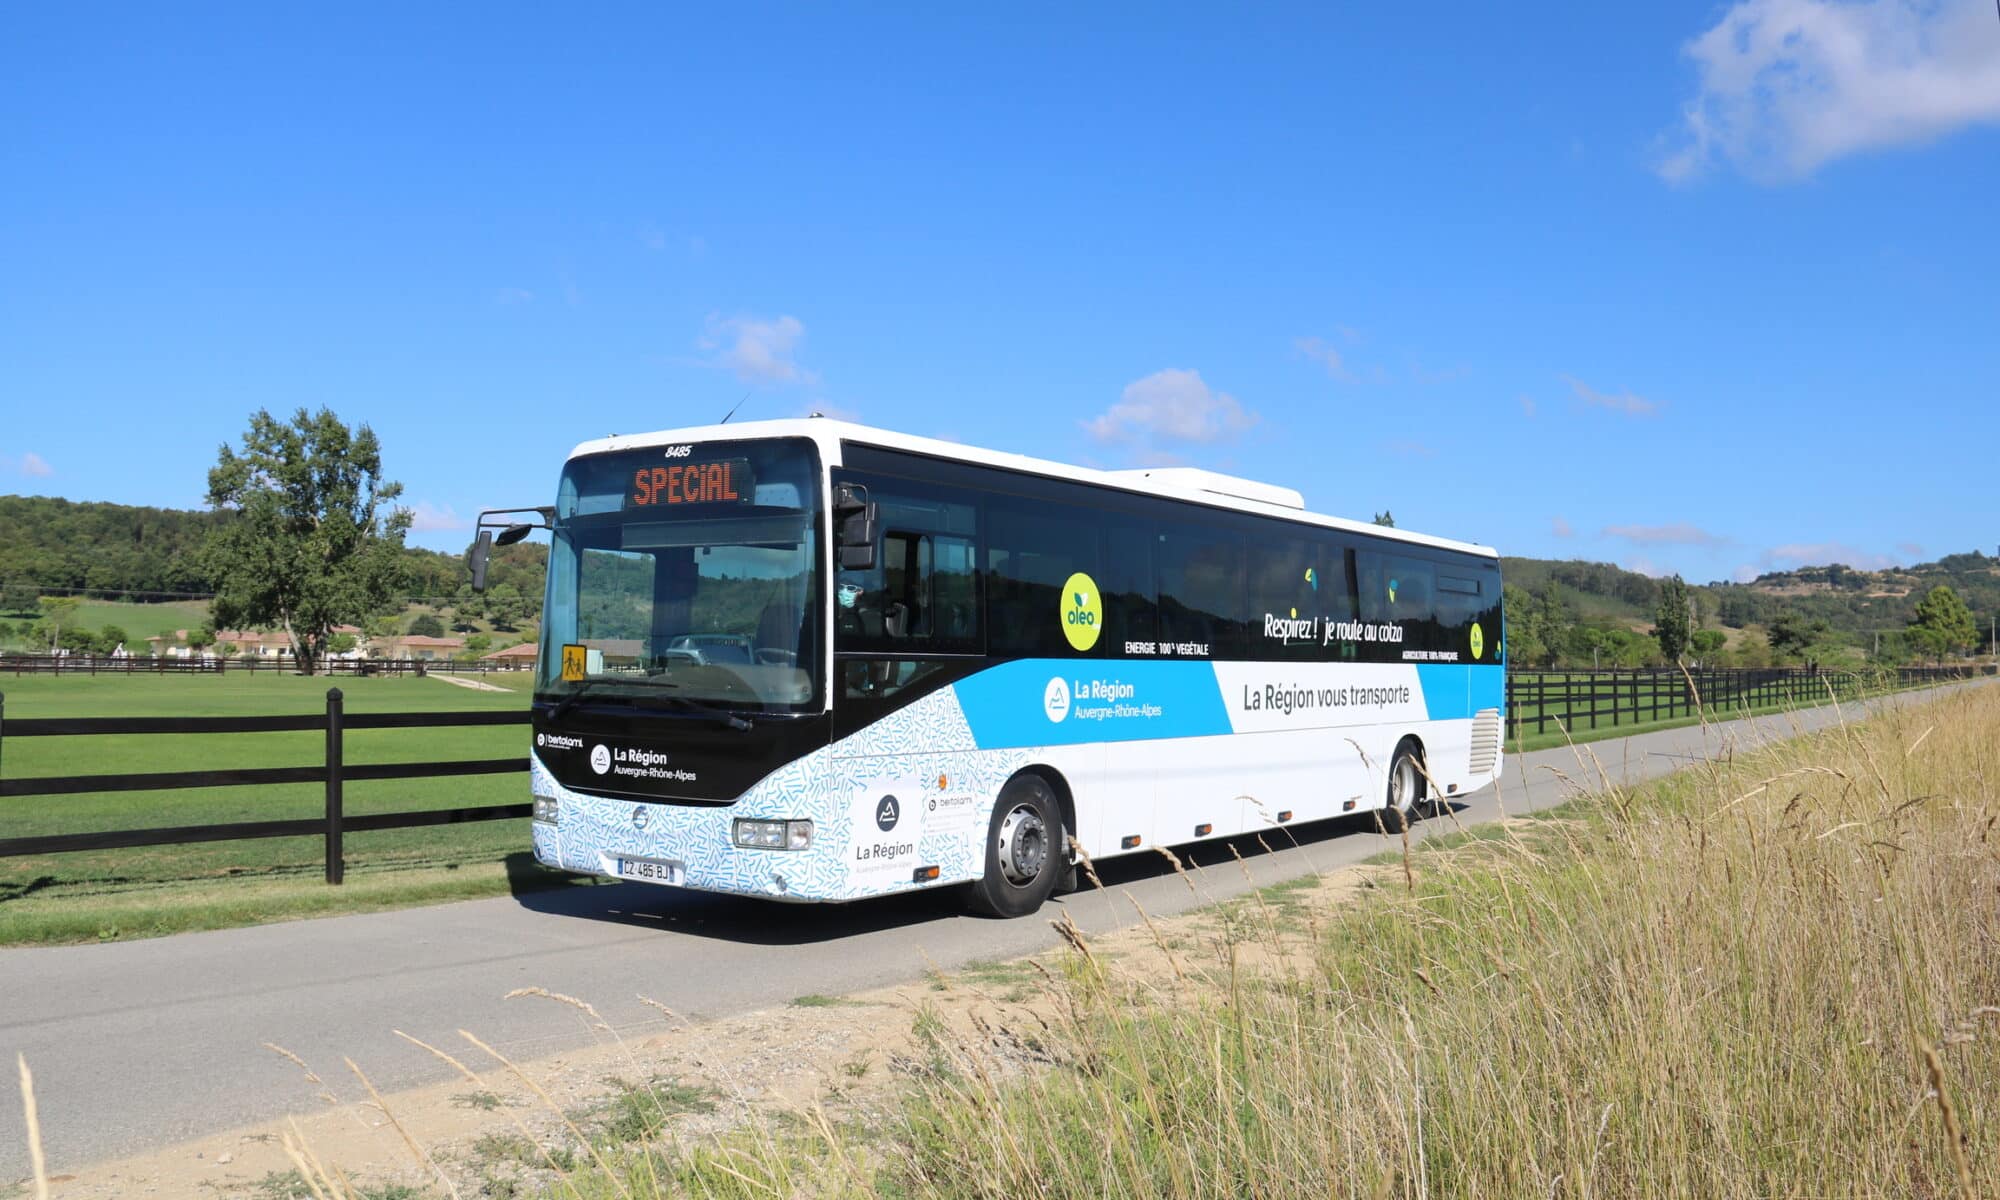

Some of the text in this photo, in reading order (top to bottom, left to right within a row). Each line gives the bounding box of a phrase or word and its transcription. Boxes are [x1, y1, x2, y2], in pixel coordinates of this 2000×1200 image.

[665, 445, 693, 458] 8485
[1067, 606, 1095, 626] oleo
[1264, 612, 1312, 646] Respirez
[1322, 616, 1335, 647] je
[1336, 618, 1363, 642] roule
[1364, 622, 1377, 642] au
[1378, 620, 1403, 643] colza
[1074, 679, 1134, 703] La Région
[1244, 682, 1410, 716] La Région vous transporte
[614, 747, 668, 767] La Région
[614, 764, 697, 782] Auvergne-Rhône-Alpes
[856, 841, 913, 860] La Région
